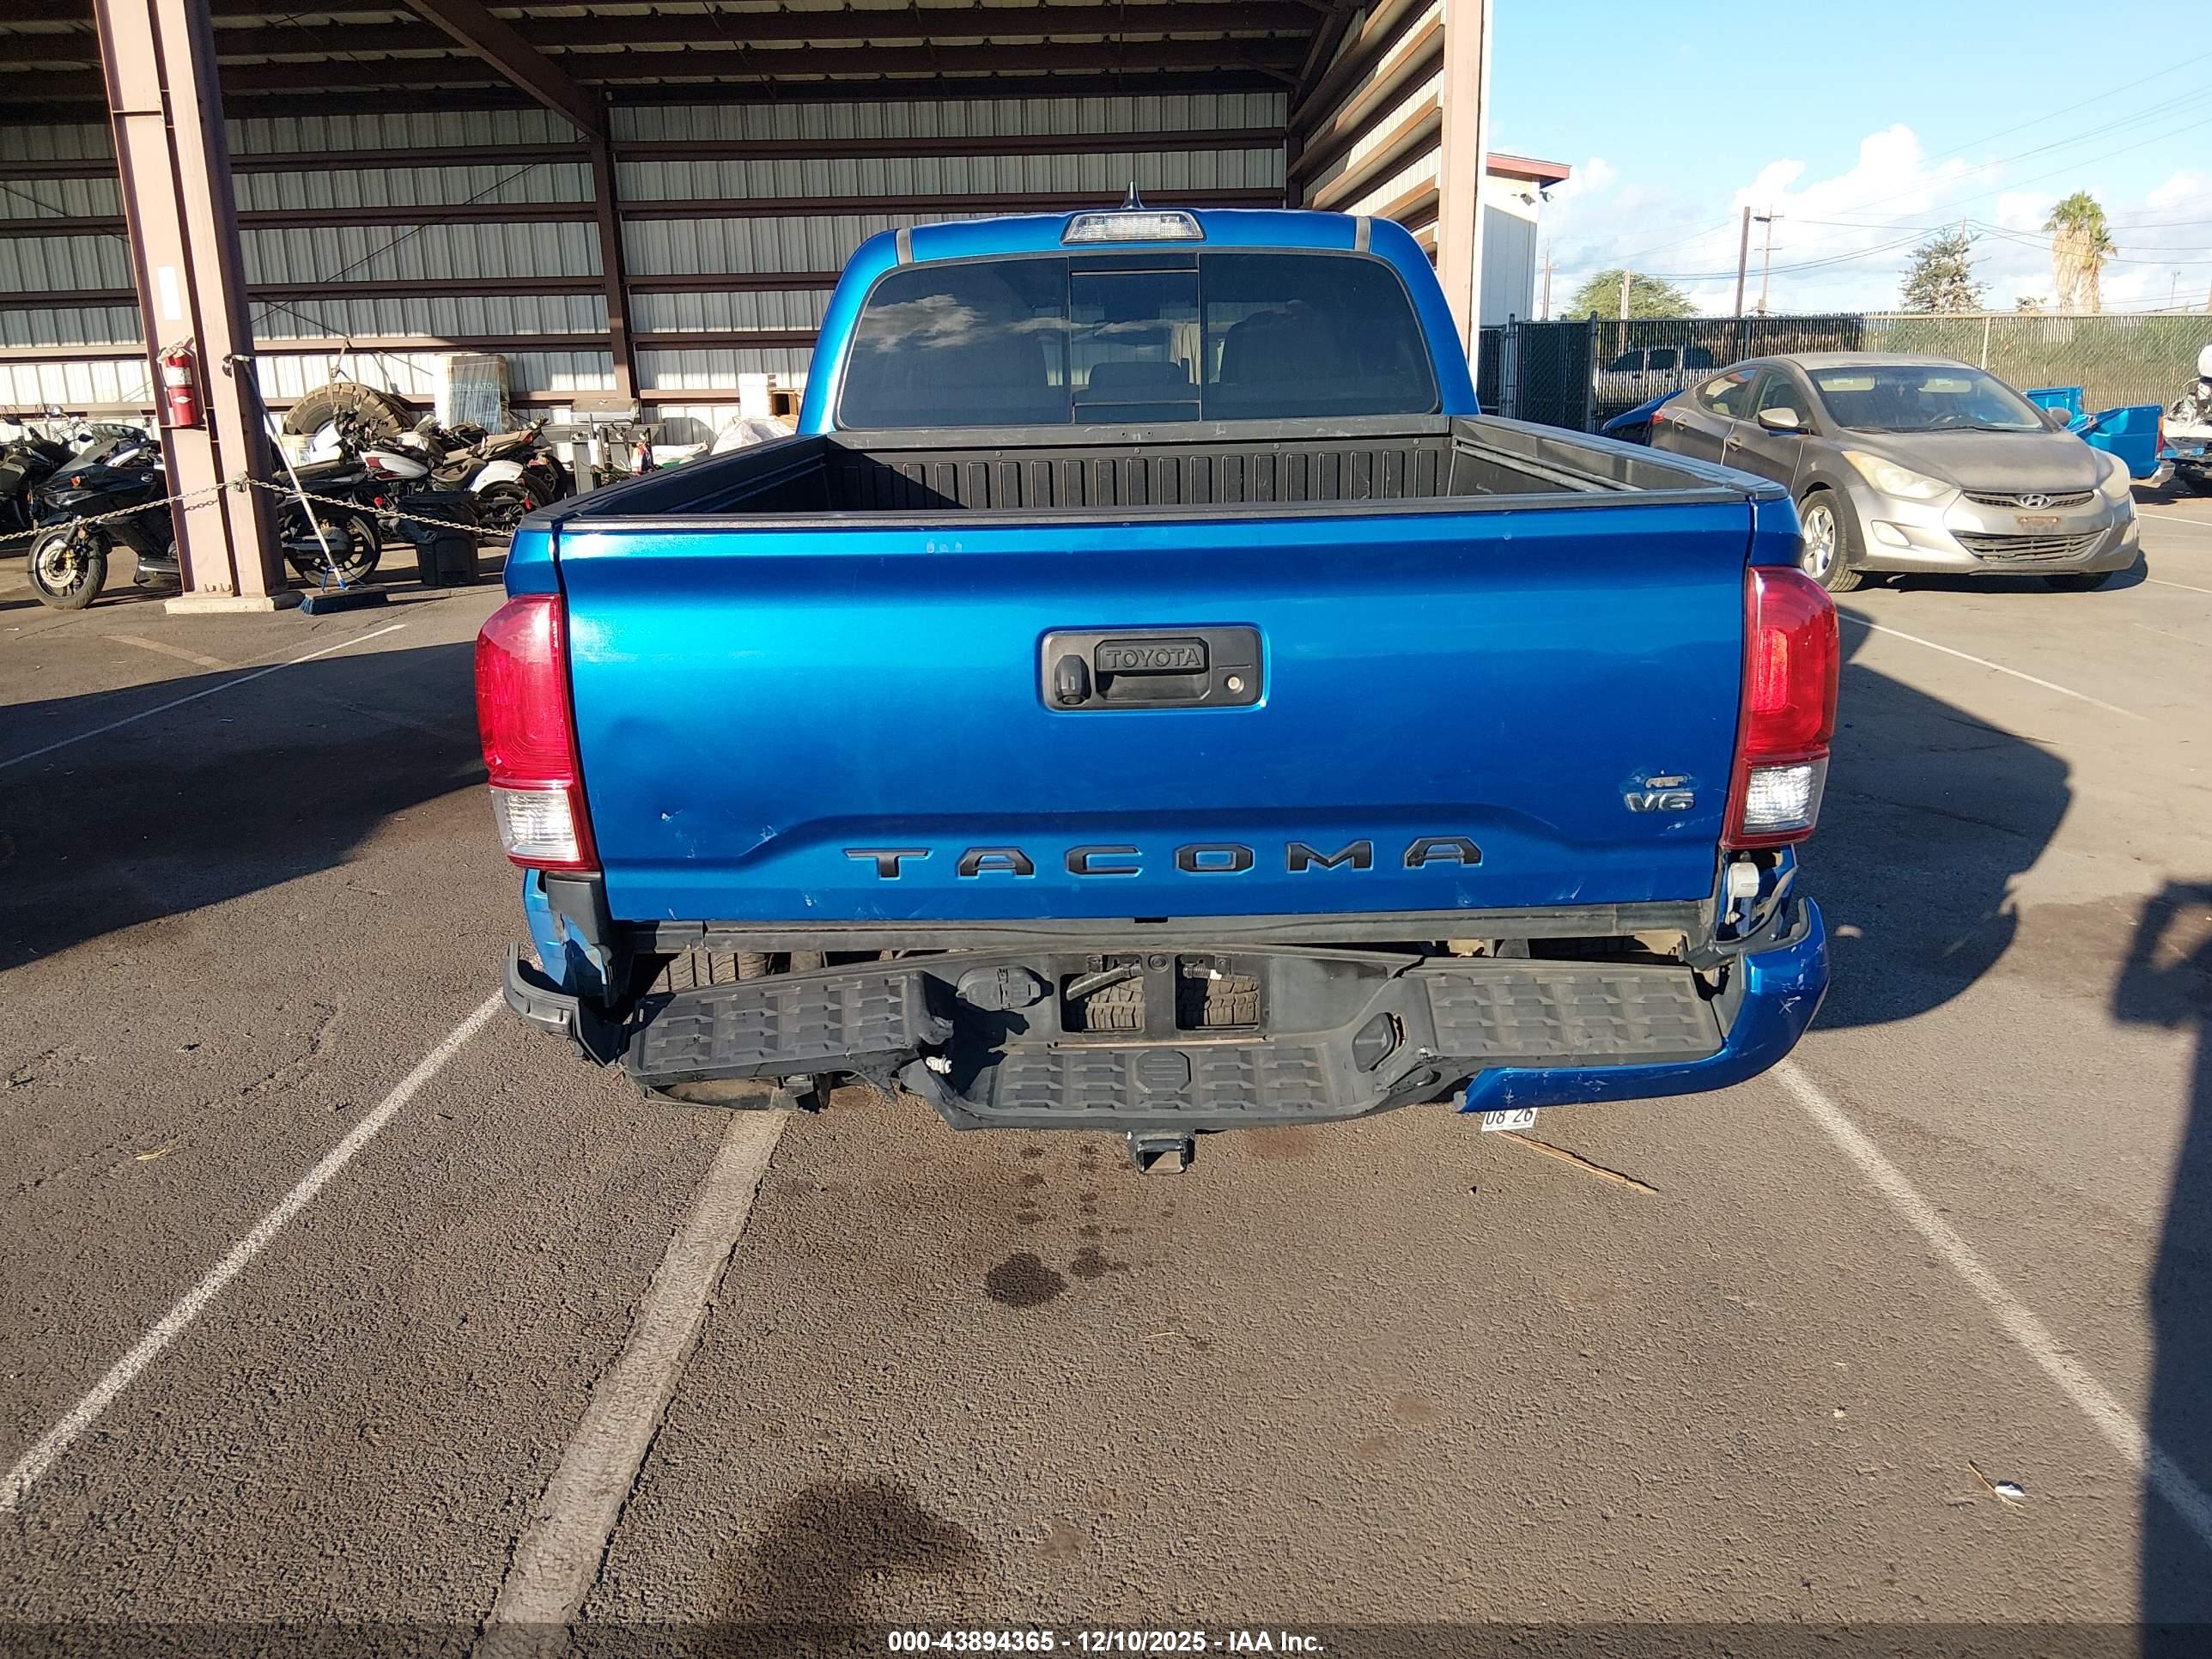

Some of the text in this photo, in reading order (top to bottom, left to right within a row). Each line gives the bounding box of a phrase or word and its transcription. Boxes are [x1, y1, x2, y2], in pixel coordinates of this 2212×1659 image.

[1106, 647, 1201, 668] TOYOTA
[1625, 792, 1695, 812] V6
[842, 836, 1484, 881] TACOMA
